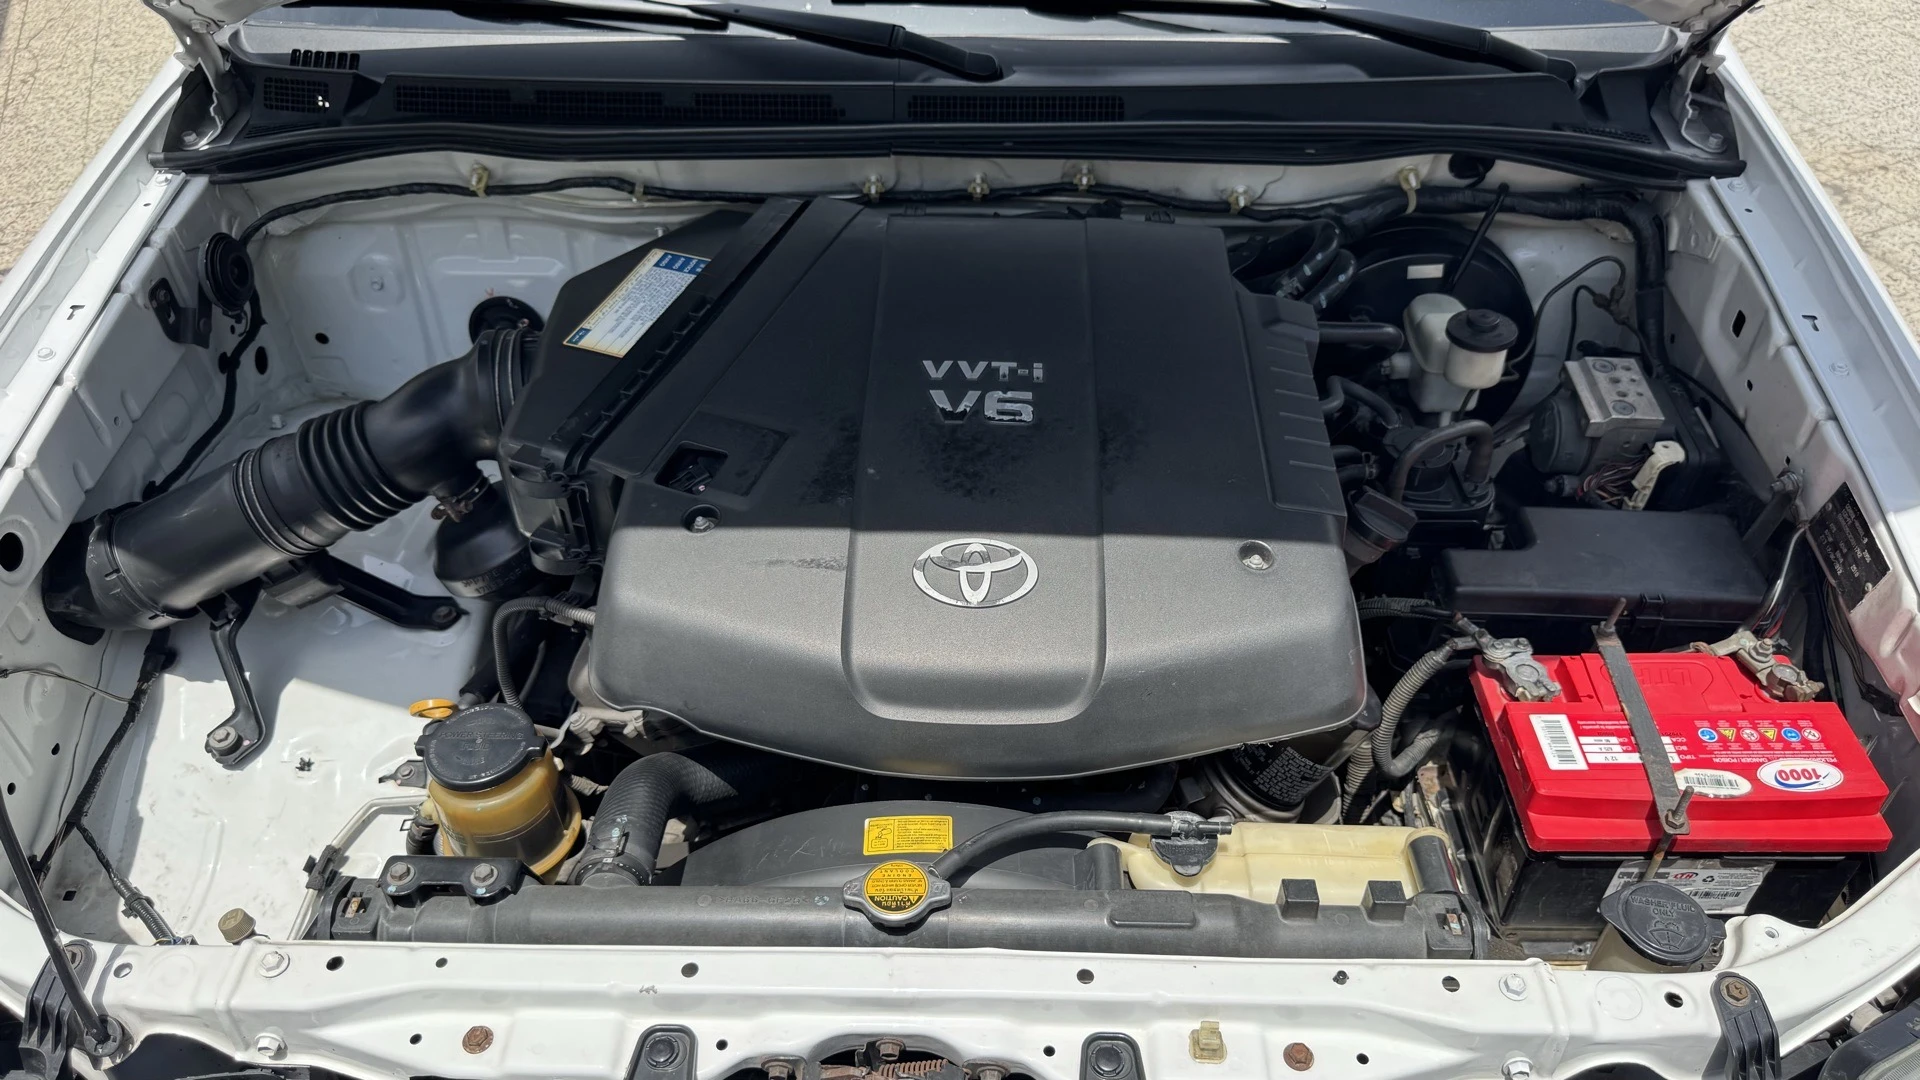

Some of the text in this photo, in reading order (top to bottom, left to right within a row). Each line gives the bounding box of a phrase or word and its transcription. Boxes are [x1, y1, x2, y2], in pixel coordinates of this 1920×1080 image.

[922, 360, 1043, 382] VVT-i
[929, 389, 1034, 425] V6
[441, 730, 524, 739] POWER STEERING
[1777, 767, 1822, 782] 1000
[1630, 895, 1697, 913] WASHER FLUID
[1652, 907, 1676, 917] ONLY
